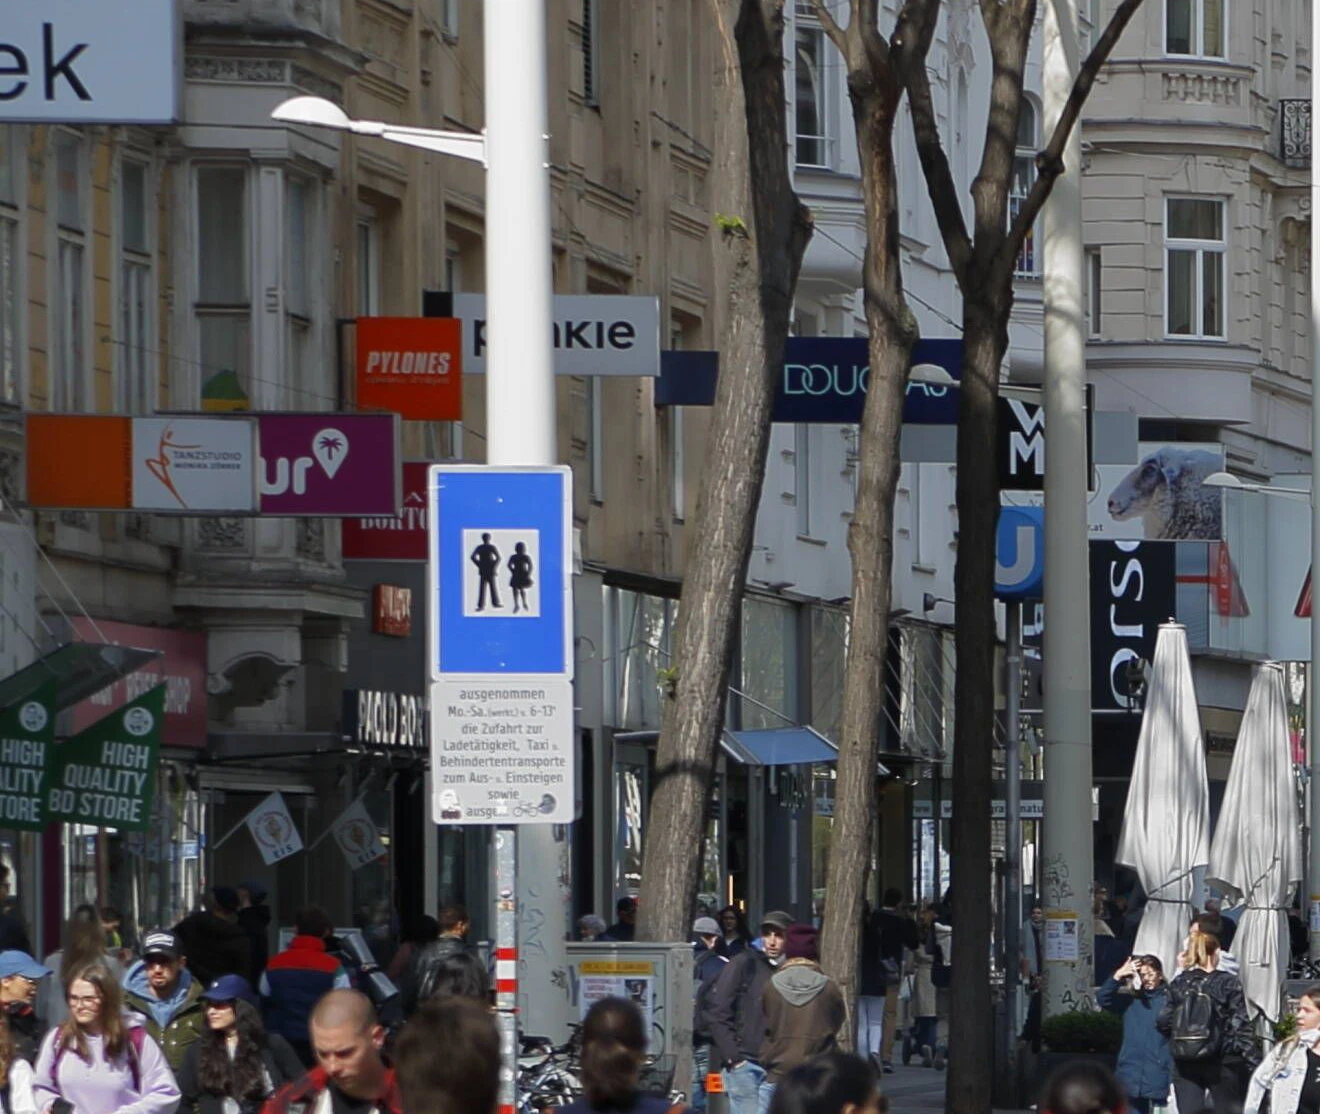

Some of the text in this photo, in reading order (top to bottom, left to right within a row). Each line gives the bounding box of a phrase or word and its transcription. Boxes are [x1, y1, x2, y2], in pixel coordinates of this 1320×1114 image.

[366, 351, 451, 375] PYLONES
[173, 451, 242, 461] TANZSTUDIO
[460, 690, 545, 702] ausgenommen
[461, 722, 544, 735] die Zufahrt zur
[526, 739, 549, 751] Taxi
[1, 738, 46, 767] HIGH
[101, 740, 150, 769] HIGH
[440, 756, 566, 768] Behindertentransporte
[64, 763, 148, 796] QUALITY
[443, 774, 466, 784] zum
[505, 772, 564, 785] Einsteigen
[487, 787, 520, 800] sowie
[79, 791, 144, 823] STORE
